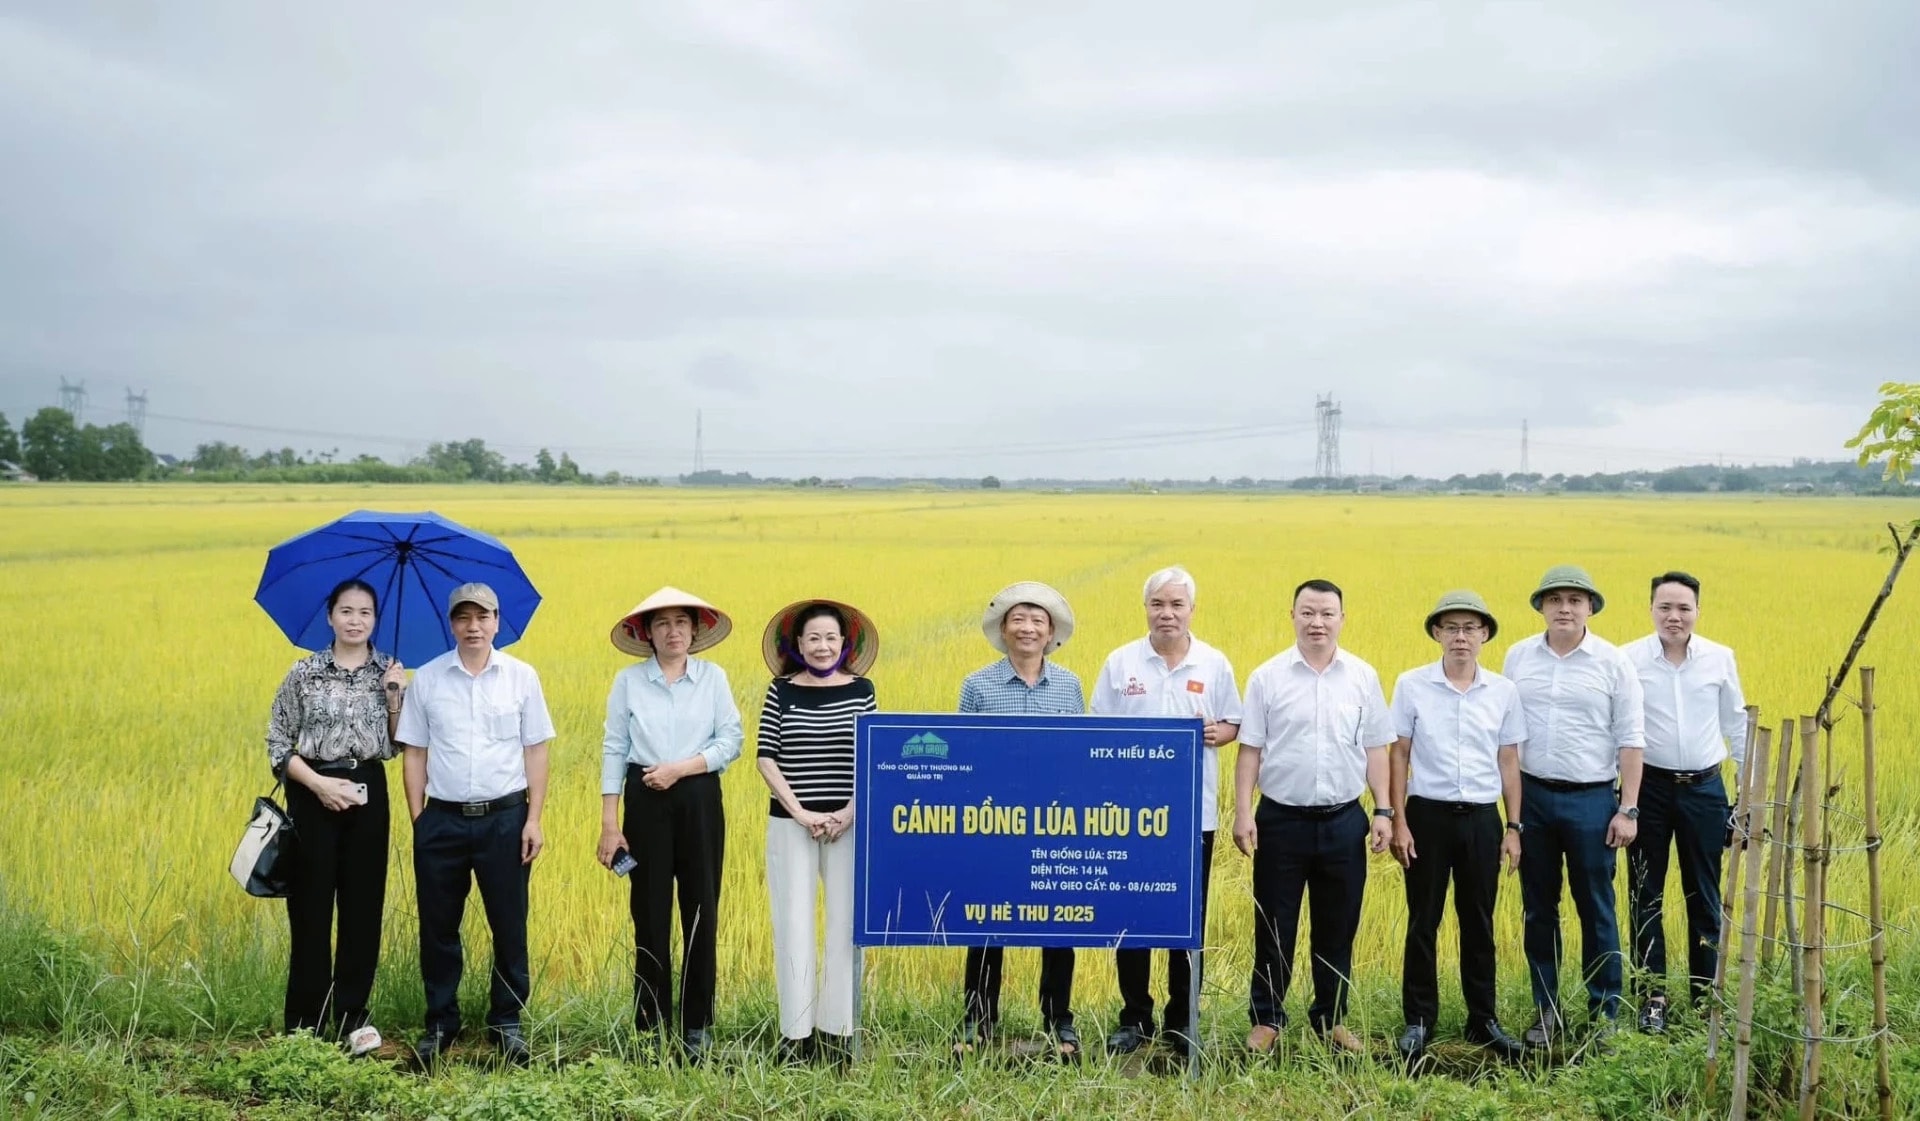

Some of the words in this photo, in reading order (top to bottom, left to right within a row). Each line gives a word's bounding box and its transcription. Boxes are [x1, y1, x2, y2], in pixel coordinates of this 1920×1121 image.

[1090, 747, 1114, 759] HTX
[1117, 744, 1145, 759] HIẾU
[1148, 744, 1175, 760] BẮC
[877, 761, 896, 771] TỔNG
[898, 763, 919, 771] CÔNG
[930, 764, 958, 772] THƯƠNG
[960, 764, 973, 773] MẠI
[906, 771, 932, 780] QUẢNG
[933, 773, 943, 782] TRỊ
[892, 798, 956, 834] CÁNH
[962, 795, 1026, 835] ĐỒNG
[1034, 800, 1077, 836] LÚA
[1084, 801, 1130, 836] HỮU
[1137, 805, 1169, 837] CƠ
[1031, 848, 1047, 859] TÊN
[1050, 846, 1082, 860] GIỐNG
[1084, 848, 1105, 860] LÚA:
[1106, 850, 1128, 860] ST25
[1031, 863, 1052, 877] DIỆN
[1054, 863, 1079, 875] TÍCH:
[1081, 866, 1092, 875] 14
[1094, 866, 1109, 875] HA
[1031, 879, 1058, 891] NGÀY
[1060, 881, 1083, 891] GIEO
[1085, 877, 1107, 891] CẤY:
[1109, 881, 1121, 892] 06
[1128, 881, 1177, 892] 08/6/2025
[964, 904, 986, 924] VỤ
[991, 901, 1012, 921] HÈ
[1017, 904, 1049, 922] THU
[1053, 905, 1095, 923] 2025
